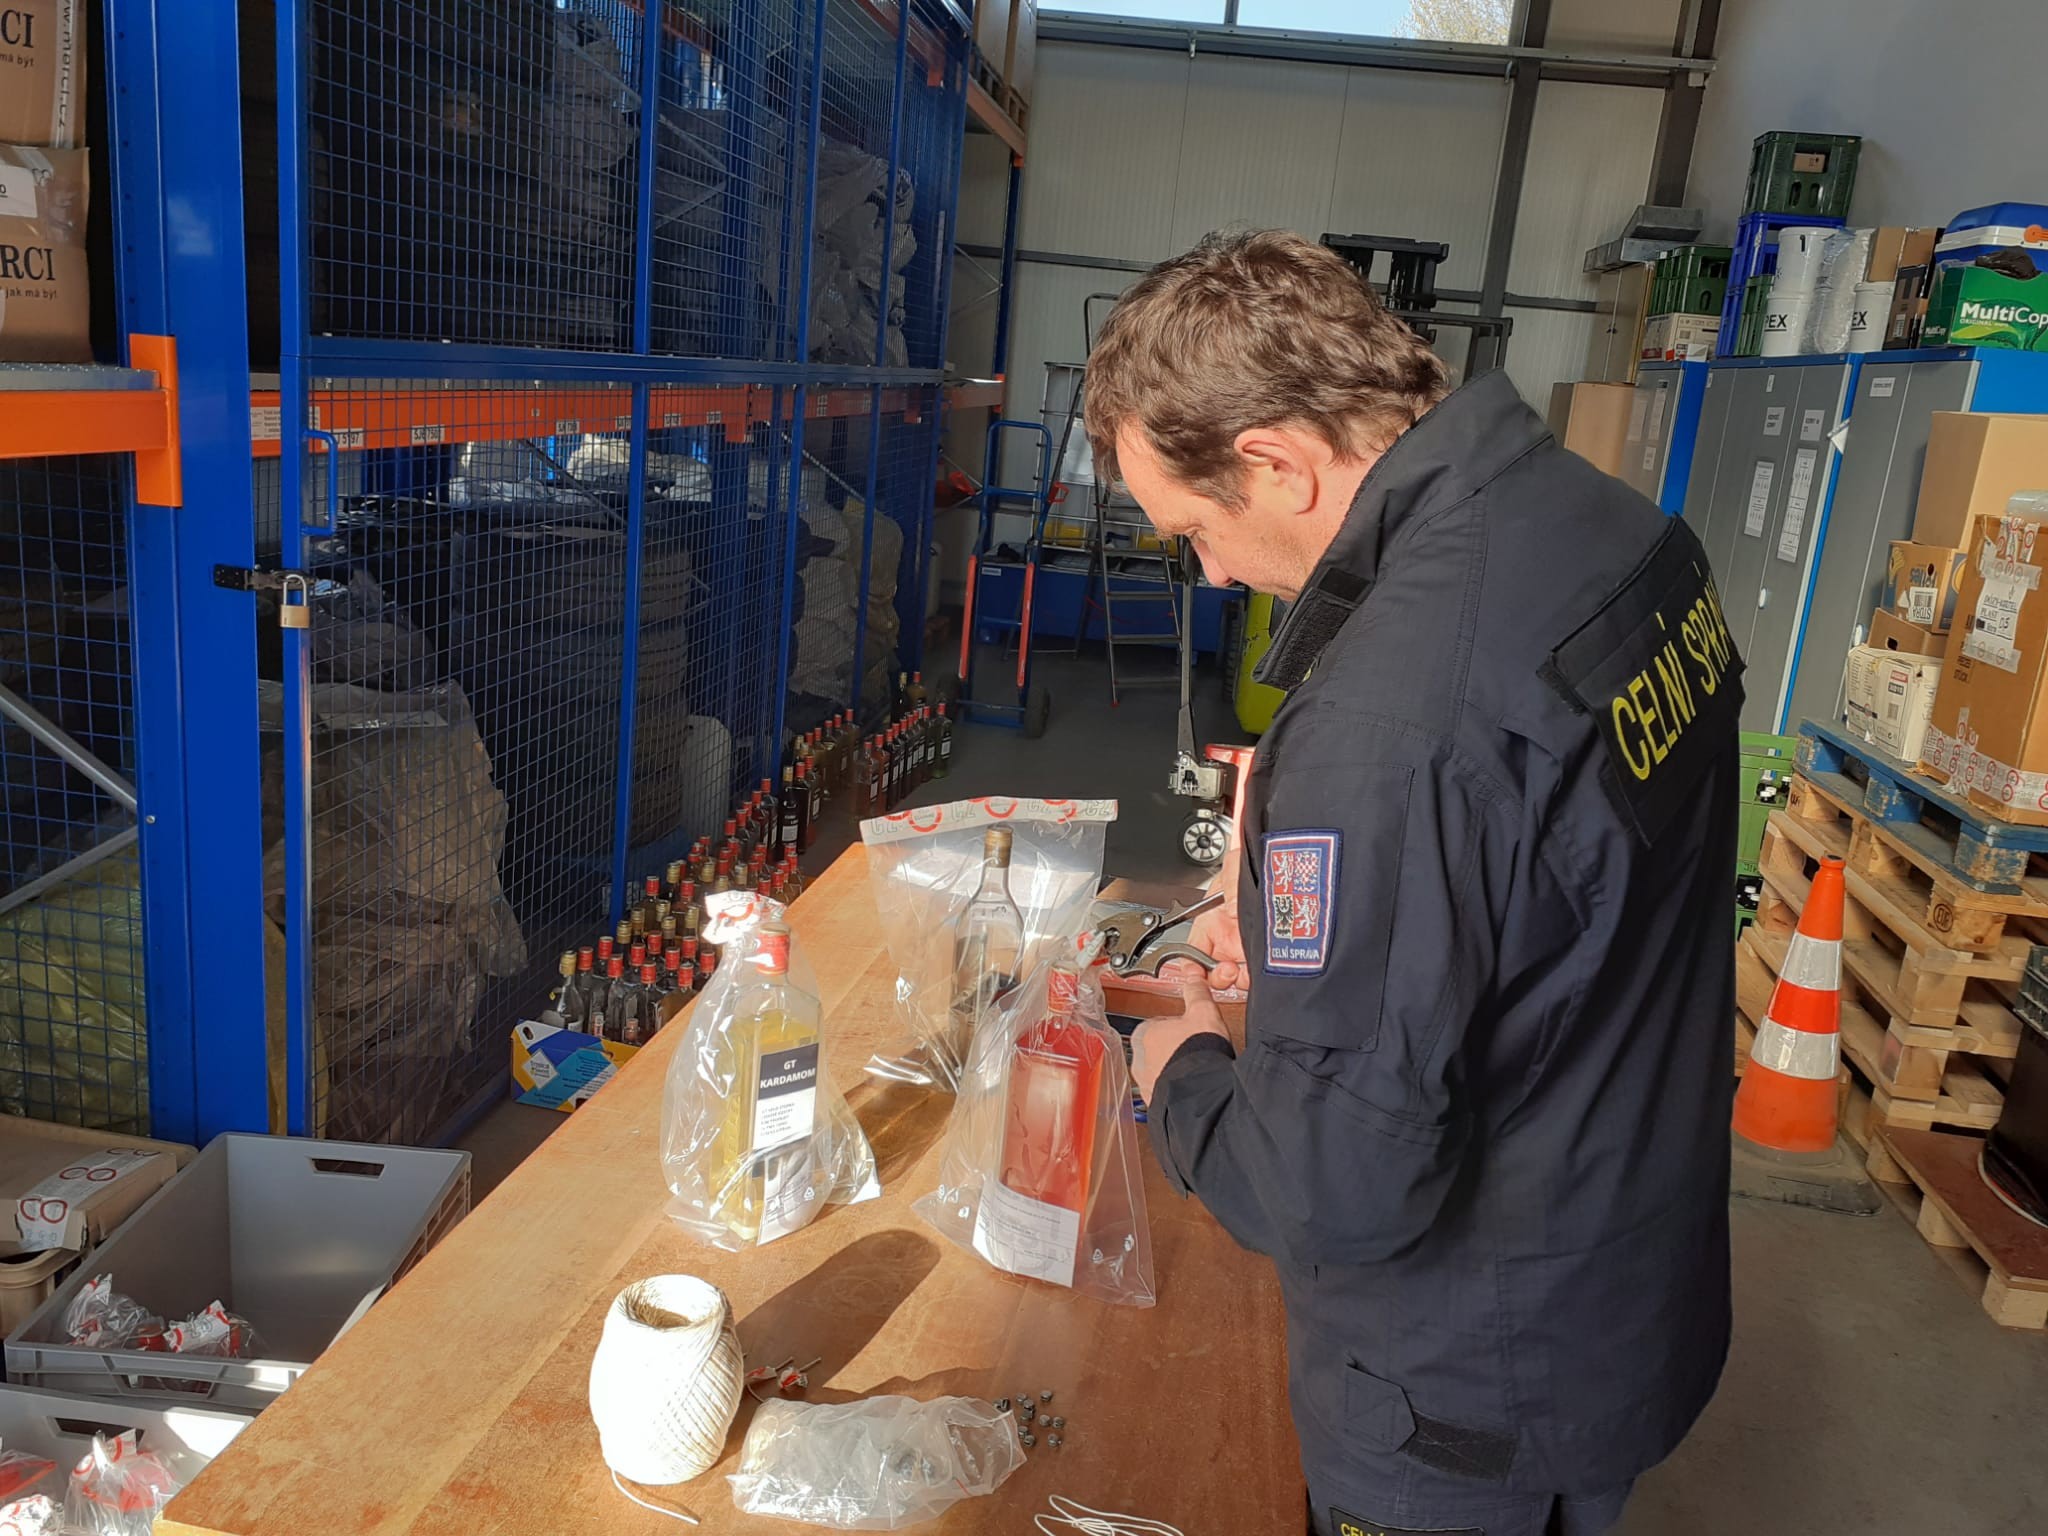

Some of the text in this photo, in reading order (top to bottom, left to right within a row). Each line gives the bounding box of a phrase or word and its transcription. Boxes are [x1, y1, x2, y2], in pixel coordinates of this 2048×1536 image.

[1765, 313, 1788, 328] EX
[1612, 611, 1696, 781] CELNÍ
[1272, 946, 1319, 960] CELNÍ SPRÁVA
[784, 1059, 797, 1070] GT
[760, 1067, 816, 1089] KARDAMOM
